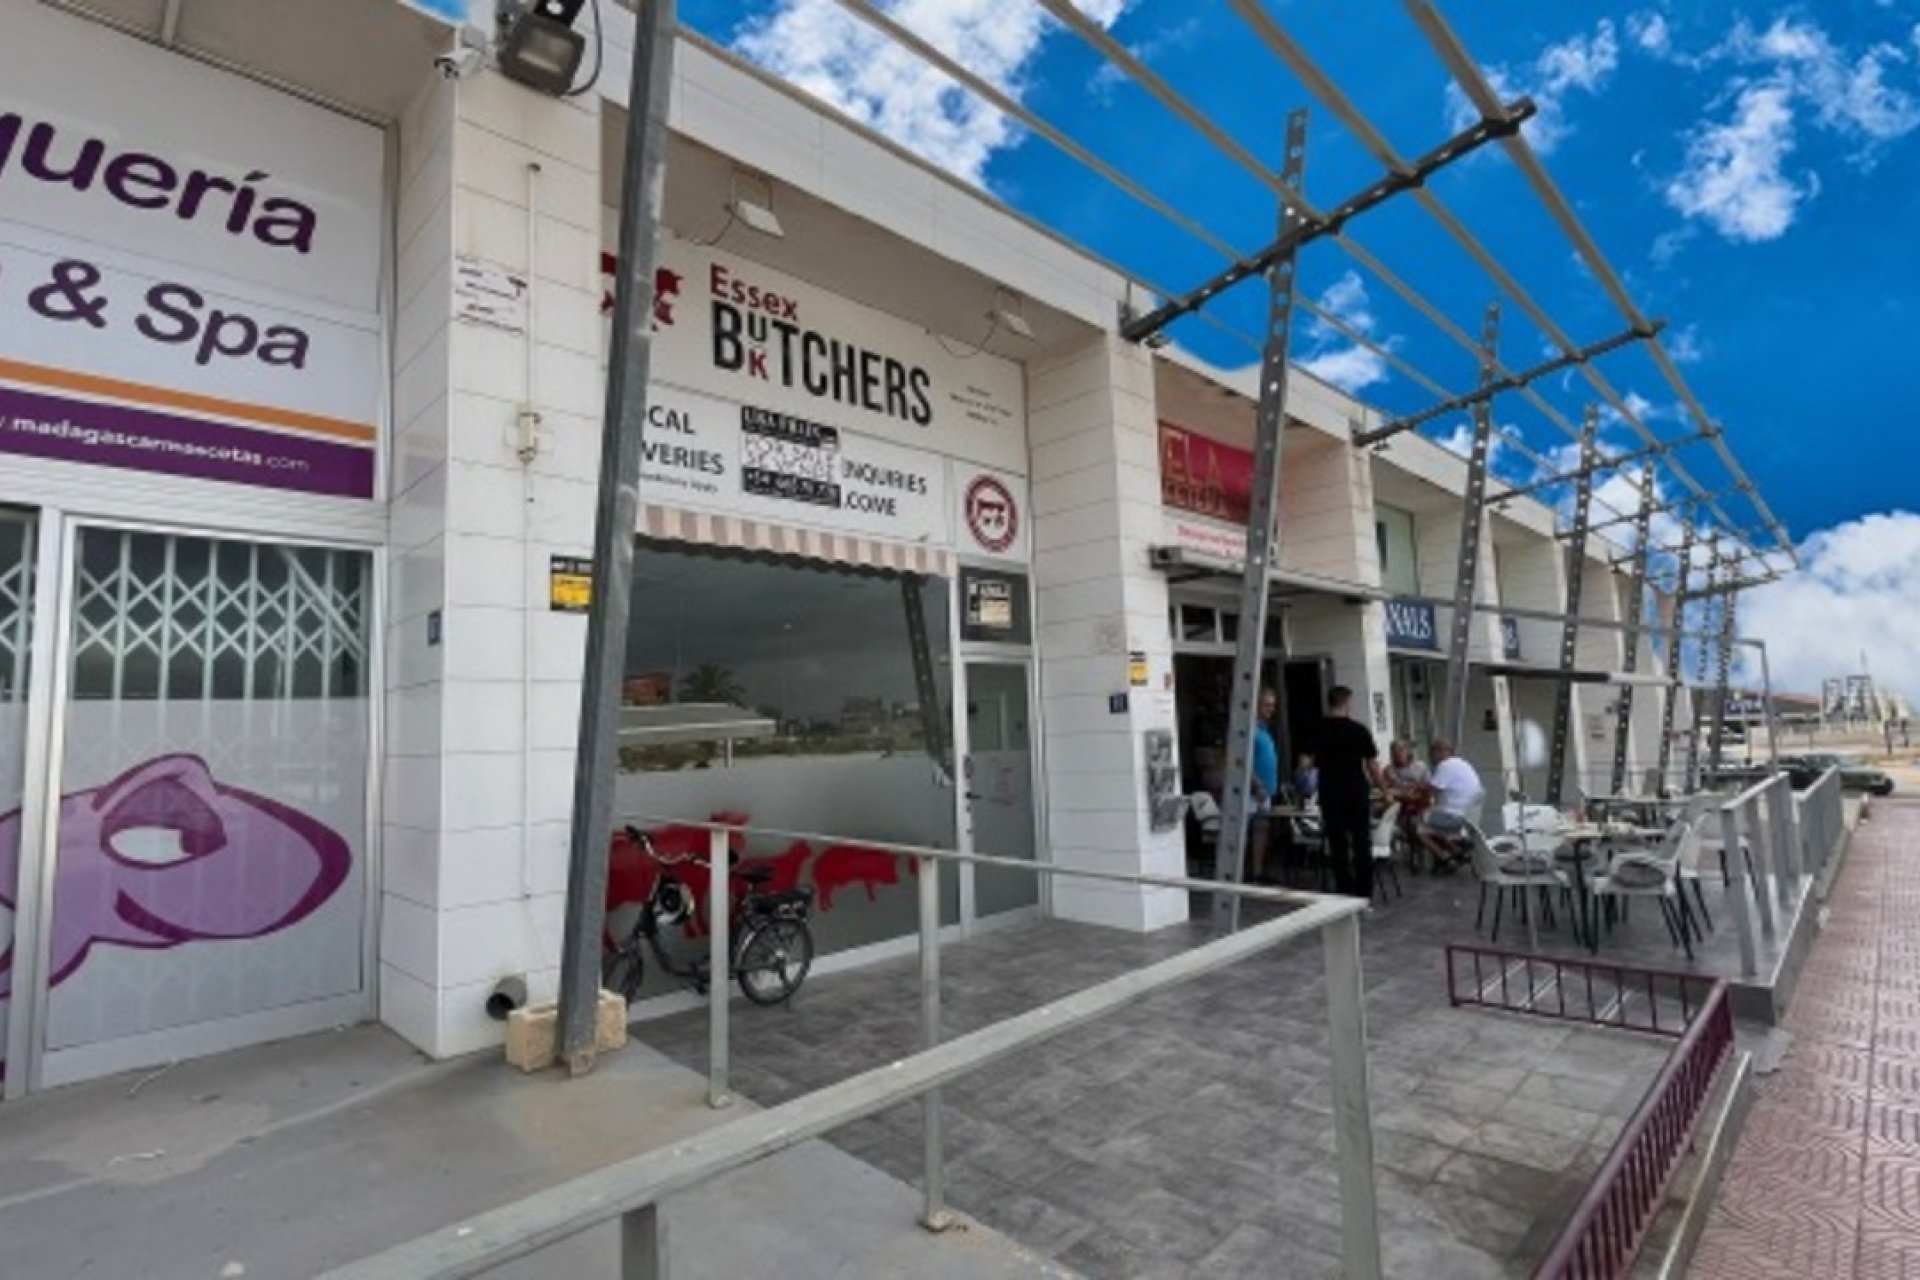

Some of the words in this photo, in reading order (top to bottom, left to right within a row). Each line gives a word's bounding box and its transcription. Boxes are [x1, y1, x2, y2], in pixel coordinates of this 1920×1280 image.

[711, 263, 797, 321] Essex
[27, 259, 108, 328] &
[135, 283, 310, 369] Spa
[643, 405, 696, 434] CAL
[845, 491, 897, 516] COME
